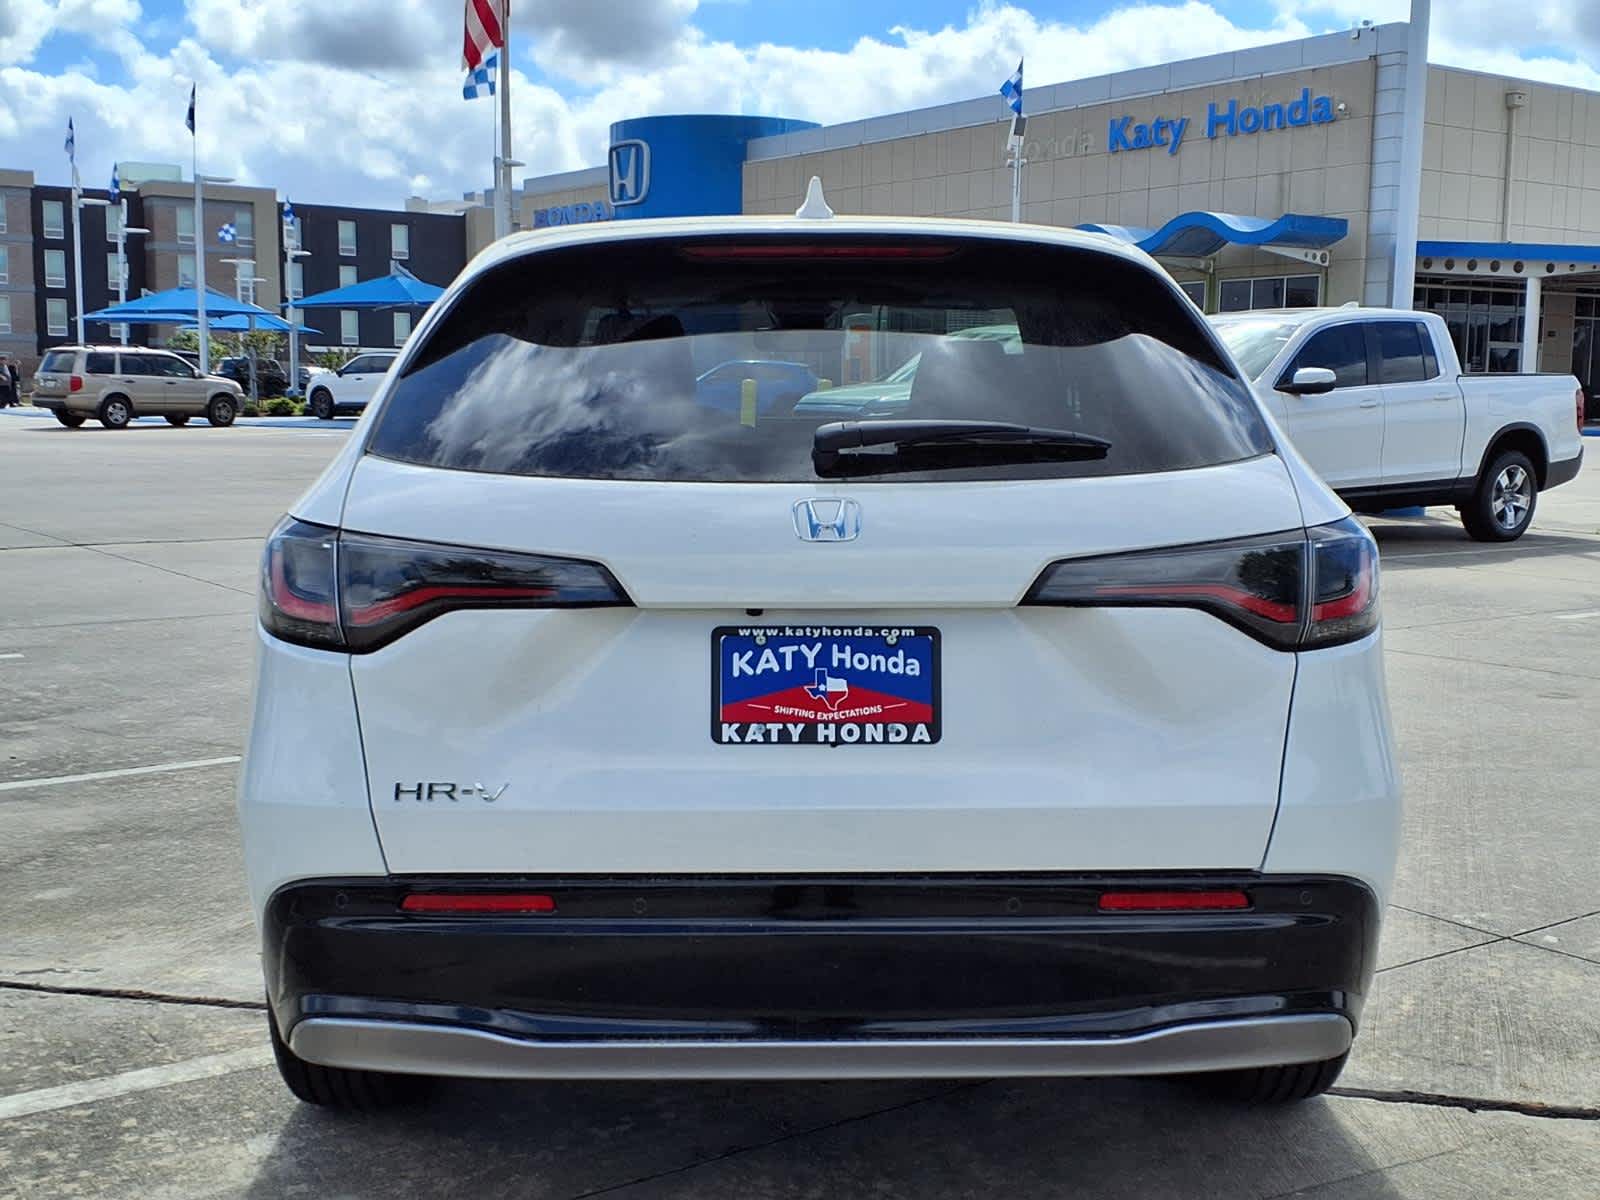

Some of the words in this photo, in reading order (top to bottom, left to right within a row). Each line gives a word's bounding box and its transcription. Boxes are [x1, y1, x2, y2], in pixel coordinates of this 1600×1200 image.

[1107, 114, 1191, 155] Katy
[1206, 87, 1336, 140] Honda
[534, 201, 608, 229] HONDA
[738, 626, 916, 638] www.katyhonda.com
[732, 642, 823, 677] KATY
[832, 643, 921, 676] Honda
[774, 705, 816, 720] SHIFTING
[817, 704, 882, 720] EXPECTATIONS
[721, 723, 806, 743] KATY
[817, 723, 932, 743] HONDA
[394, 781, 510, 802] HR-V
